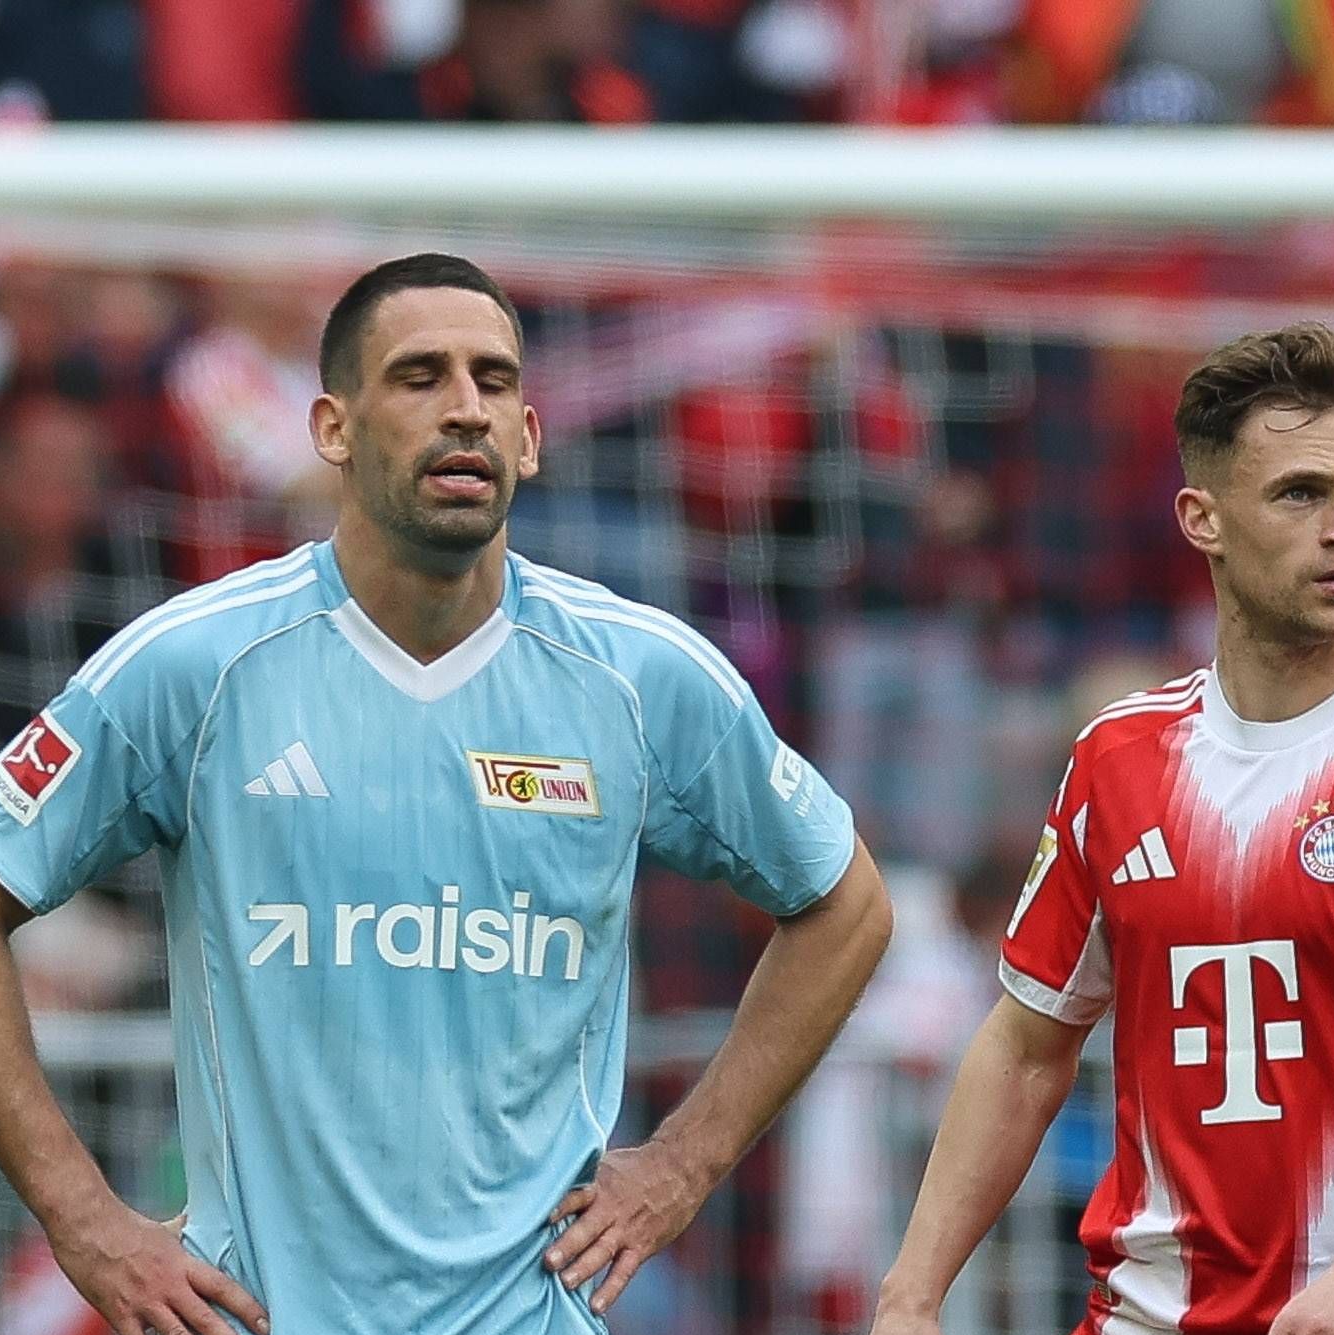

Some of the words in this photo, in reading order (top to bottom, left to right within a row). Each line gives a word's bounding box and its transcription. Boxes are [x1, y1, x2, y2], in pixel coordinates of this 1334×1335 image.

[540, 778, 589, 803] UNION
[334, 884, 585, 981] raisin
[1169, 939, 1304, 1126] T
